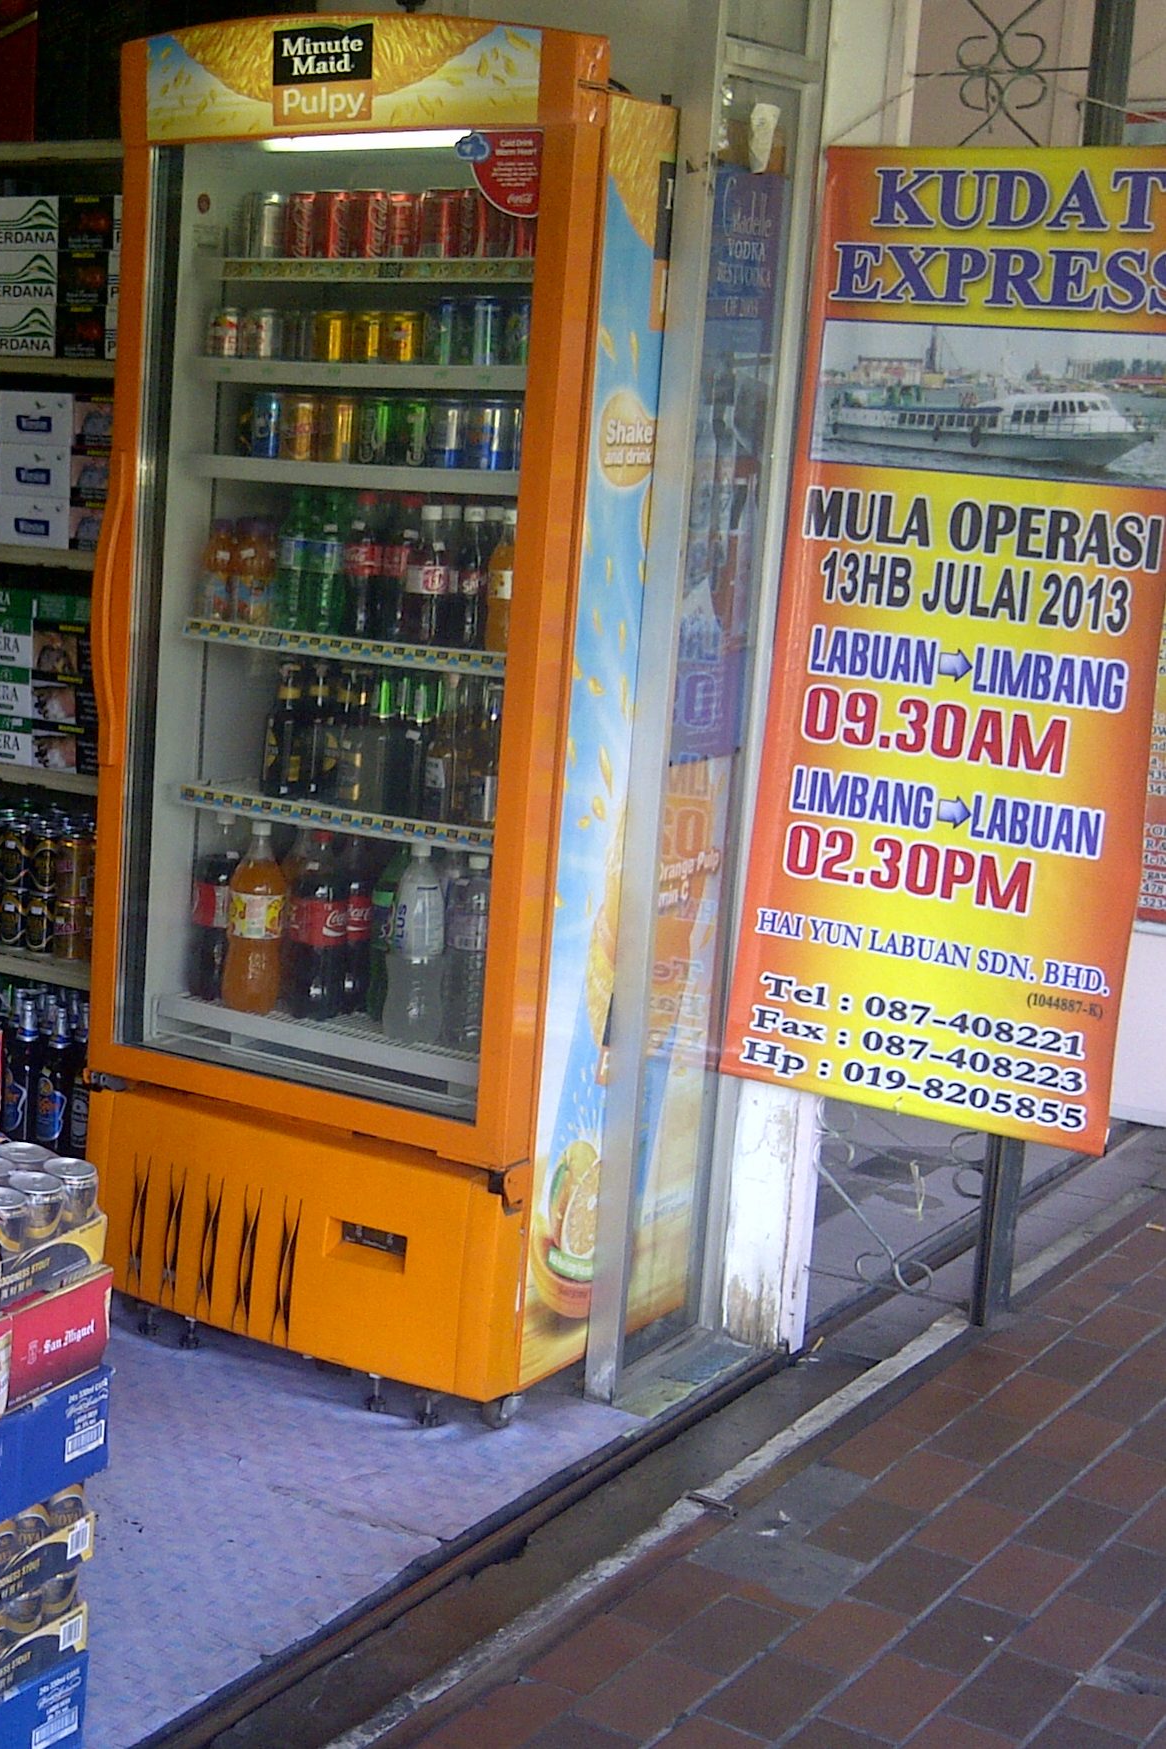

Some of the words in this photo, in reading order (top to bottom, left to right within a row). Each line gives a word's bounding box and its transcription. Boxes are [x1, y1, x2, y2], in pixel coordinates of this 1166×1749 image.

[281, 35, 364, 57] Minute
[291, 53, 352, 76] Maid
[282, 86, 365, 119] Pulpy
[871, 167, 1166, 232] KUDAT
[728, 238, 766, 261] VODKA
[604, 449, 624, 466] and
[626, 448, 652, 466] drink
[606, 418, 654, 445] Shake
[803, 486, 931, 548] MULA
[948, 500, 1164, 572] OPERASI
[821, 550, 913, 609] 13HB
[921, 560, 1031, 625] JULAI
[1037, 573, 1131, 636] 2013
[808, 627, 938, 687] LABUAN
[970, 645, 1129, 713] LIMBANG
[800, 684, 1070, 776] 09.30AM
[789, 765, 935, 831] LIMBANG
[969, 793, 1106, 857] LABUAN
[697, 852, 720, 871] Pulp
[783, 823, 1035, 916] 02.30PM
[755, 909, 804, 939] HAI
[809, 916, 864, 951] YUN
[869, 926, 973, 970] LABUAN
[976, 948, 1035, 982] SDN.
[1043, 960, 1110, 995] BHD.
[751, 1007, 826, 1046] Fax
[860, 1029, 1086, 1097] 087-408223
[761, 973, 827, 1008] Tel
[863, 994, 1086, 1059] 087-408221
[742, 1040, 806, 1077] Hp
[842, 1060, 1087, 1133] 019-8205855
[43, 1335, 64, 1354] San
[64, 1319, 95, 1347] Miguel
